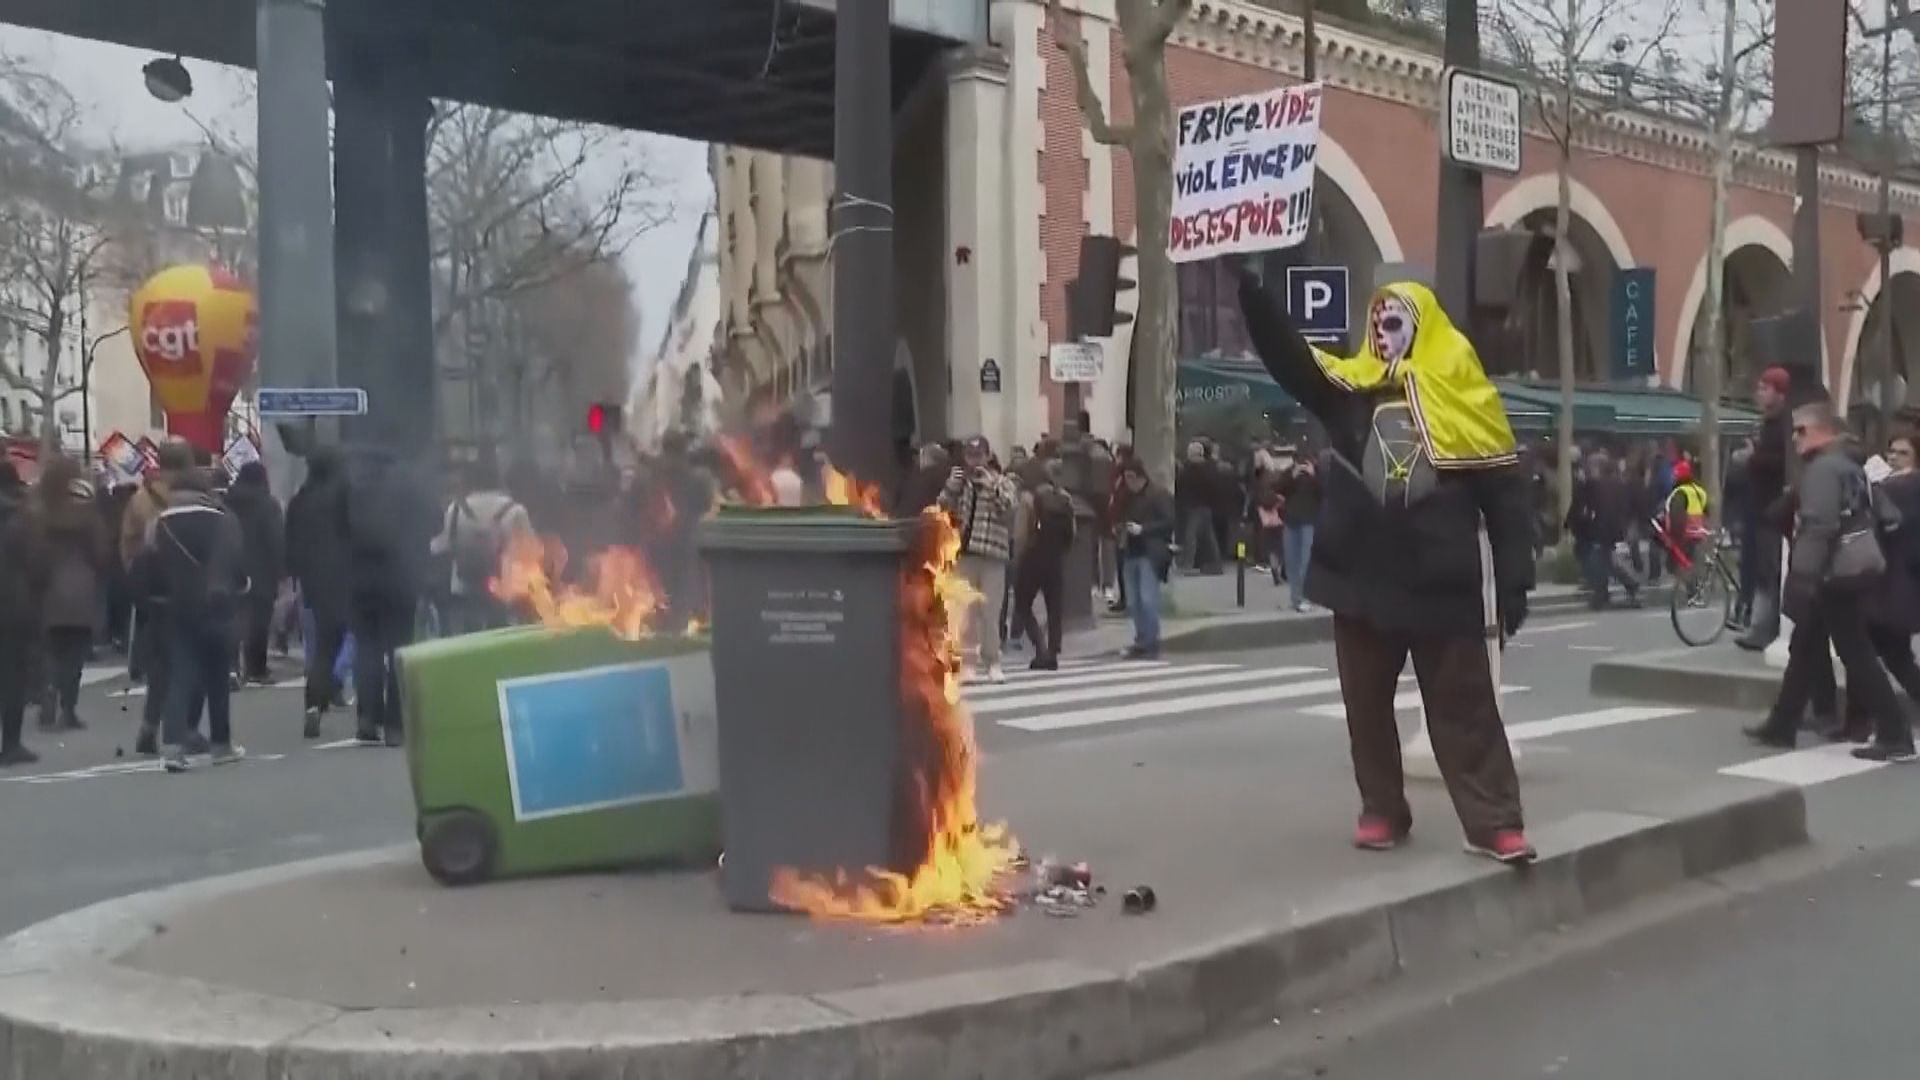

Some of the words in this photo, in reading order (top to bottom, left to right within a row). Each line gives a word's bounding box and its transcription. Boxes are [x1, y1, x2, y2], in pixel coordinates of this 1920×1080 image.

[1456, 100, 1516, 126] ATTENTION
[1456, 118, 1517, 146] TRAVERSEZ
[1291, 144, 1317, 172] DU
[1456, 137, 1469, 155] EN
[1485, 143, 1516, 165] TEMPS
[1304, 279, 1332, 320] P
[143, 320, 200, 361] cgt
